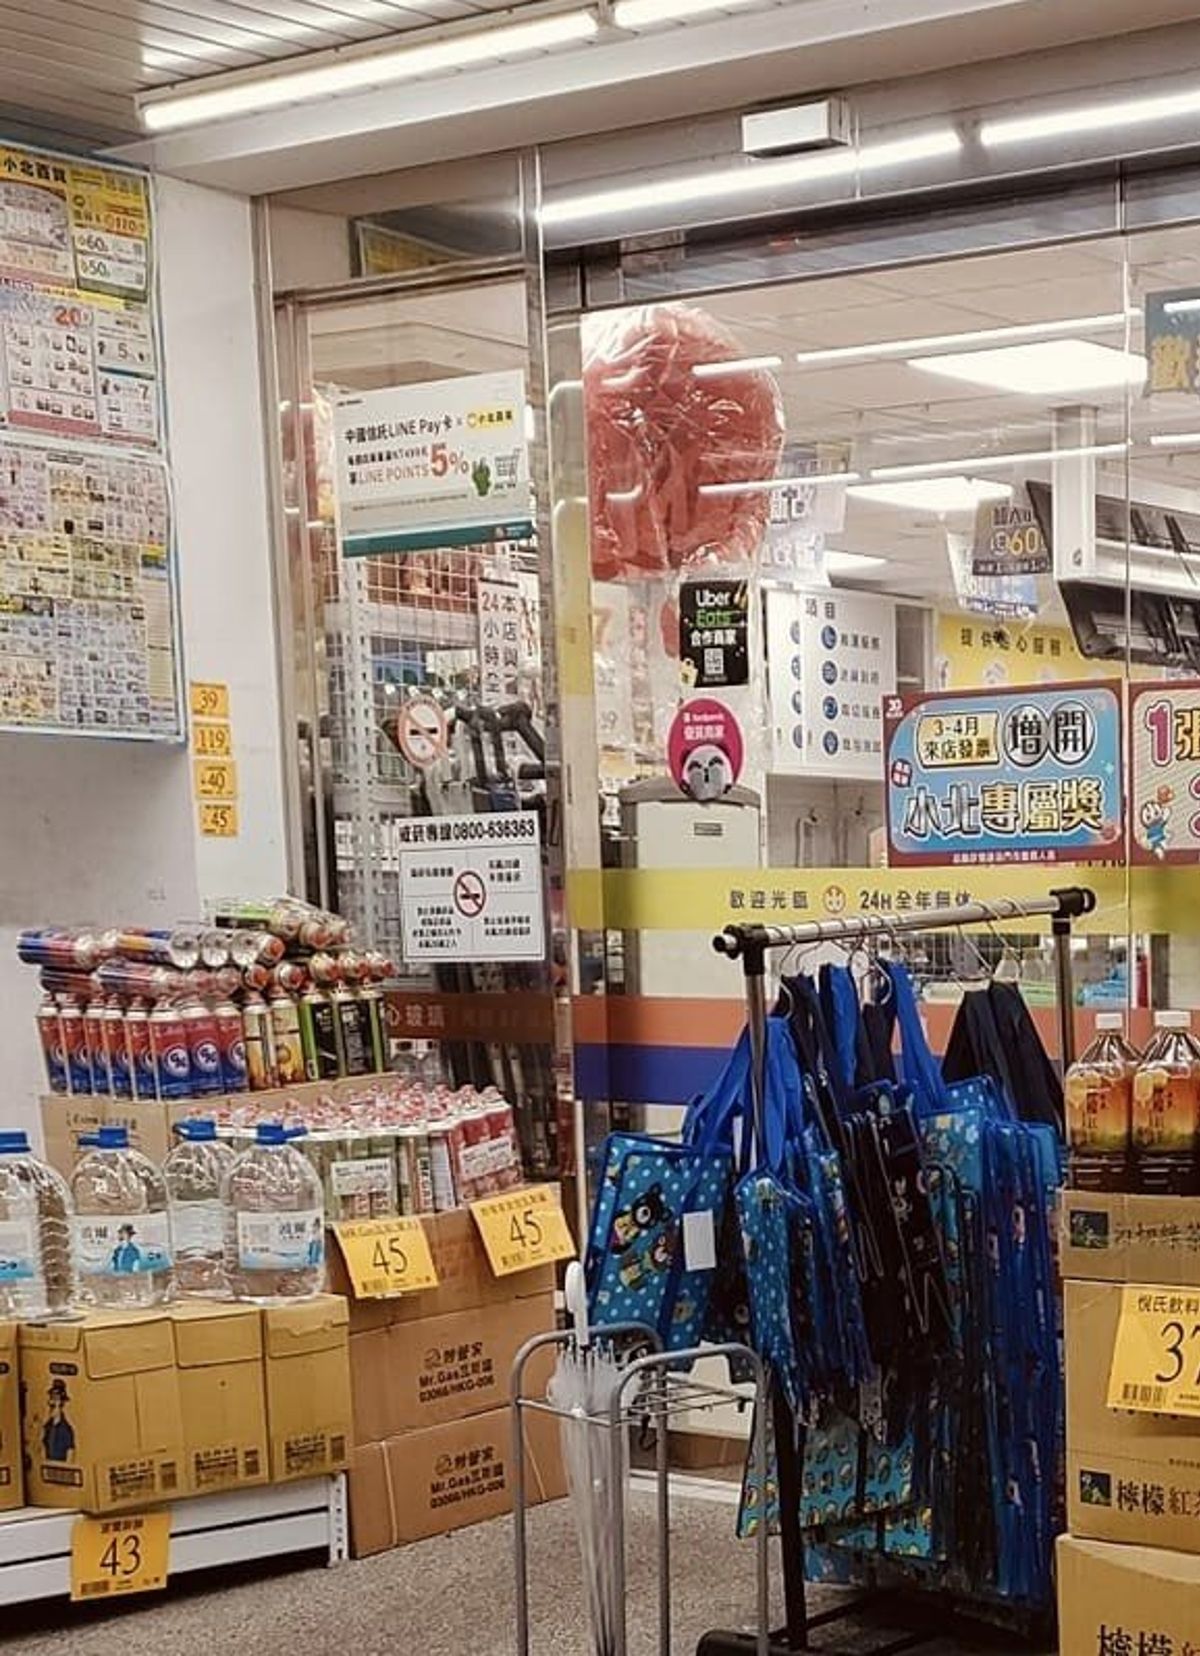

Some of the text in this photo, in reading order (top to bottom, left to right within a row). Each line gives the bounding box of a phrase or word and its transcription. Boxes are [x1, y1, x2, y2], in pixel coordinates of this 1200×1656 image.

[695, 590, 730, 606] Uber
[696, 611, 731, 628] Eats
[934, 717, 980, 736] 3-4月
[924, 738, 992, 761] 來店發票
[903, 778, 1103, 836] 小北專屬獎
[730, 889, 808, 910] 歡迎光臨
[511, 1209, 543, 1248] 45
[373, 1237, 408, 1276] 45
[100, 1534, 141, 1576] 43
